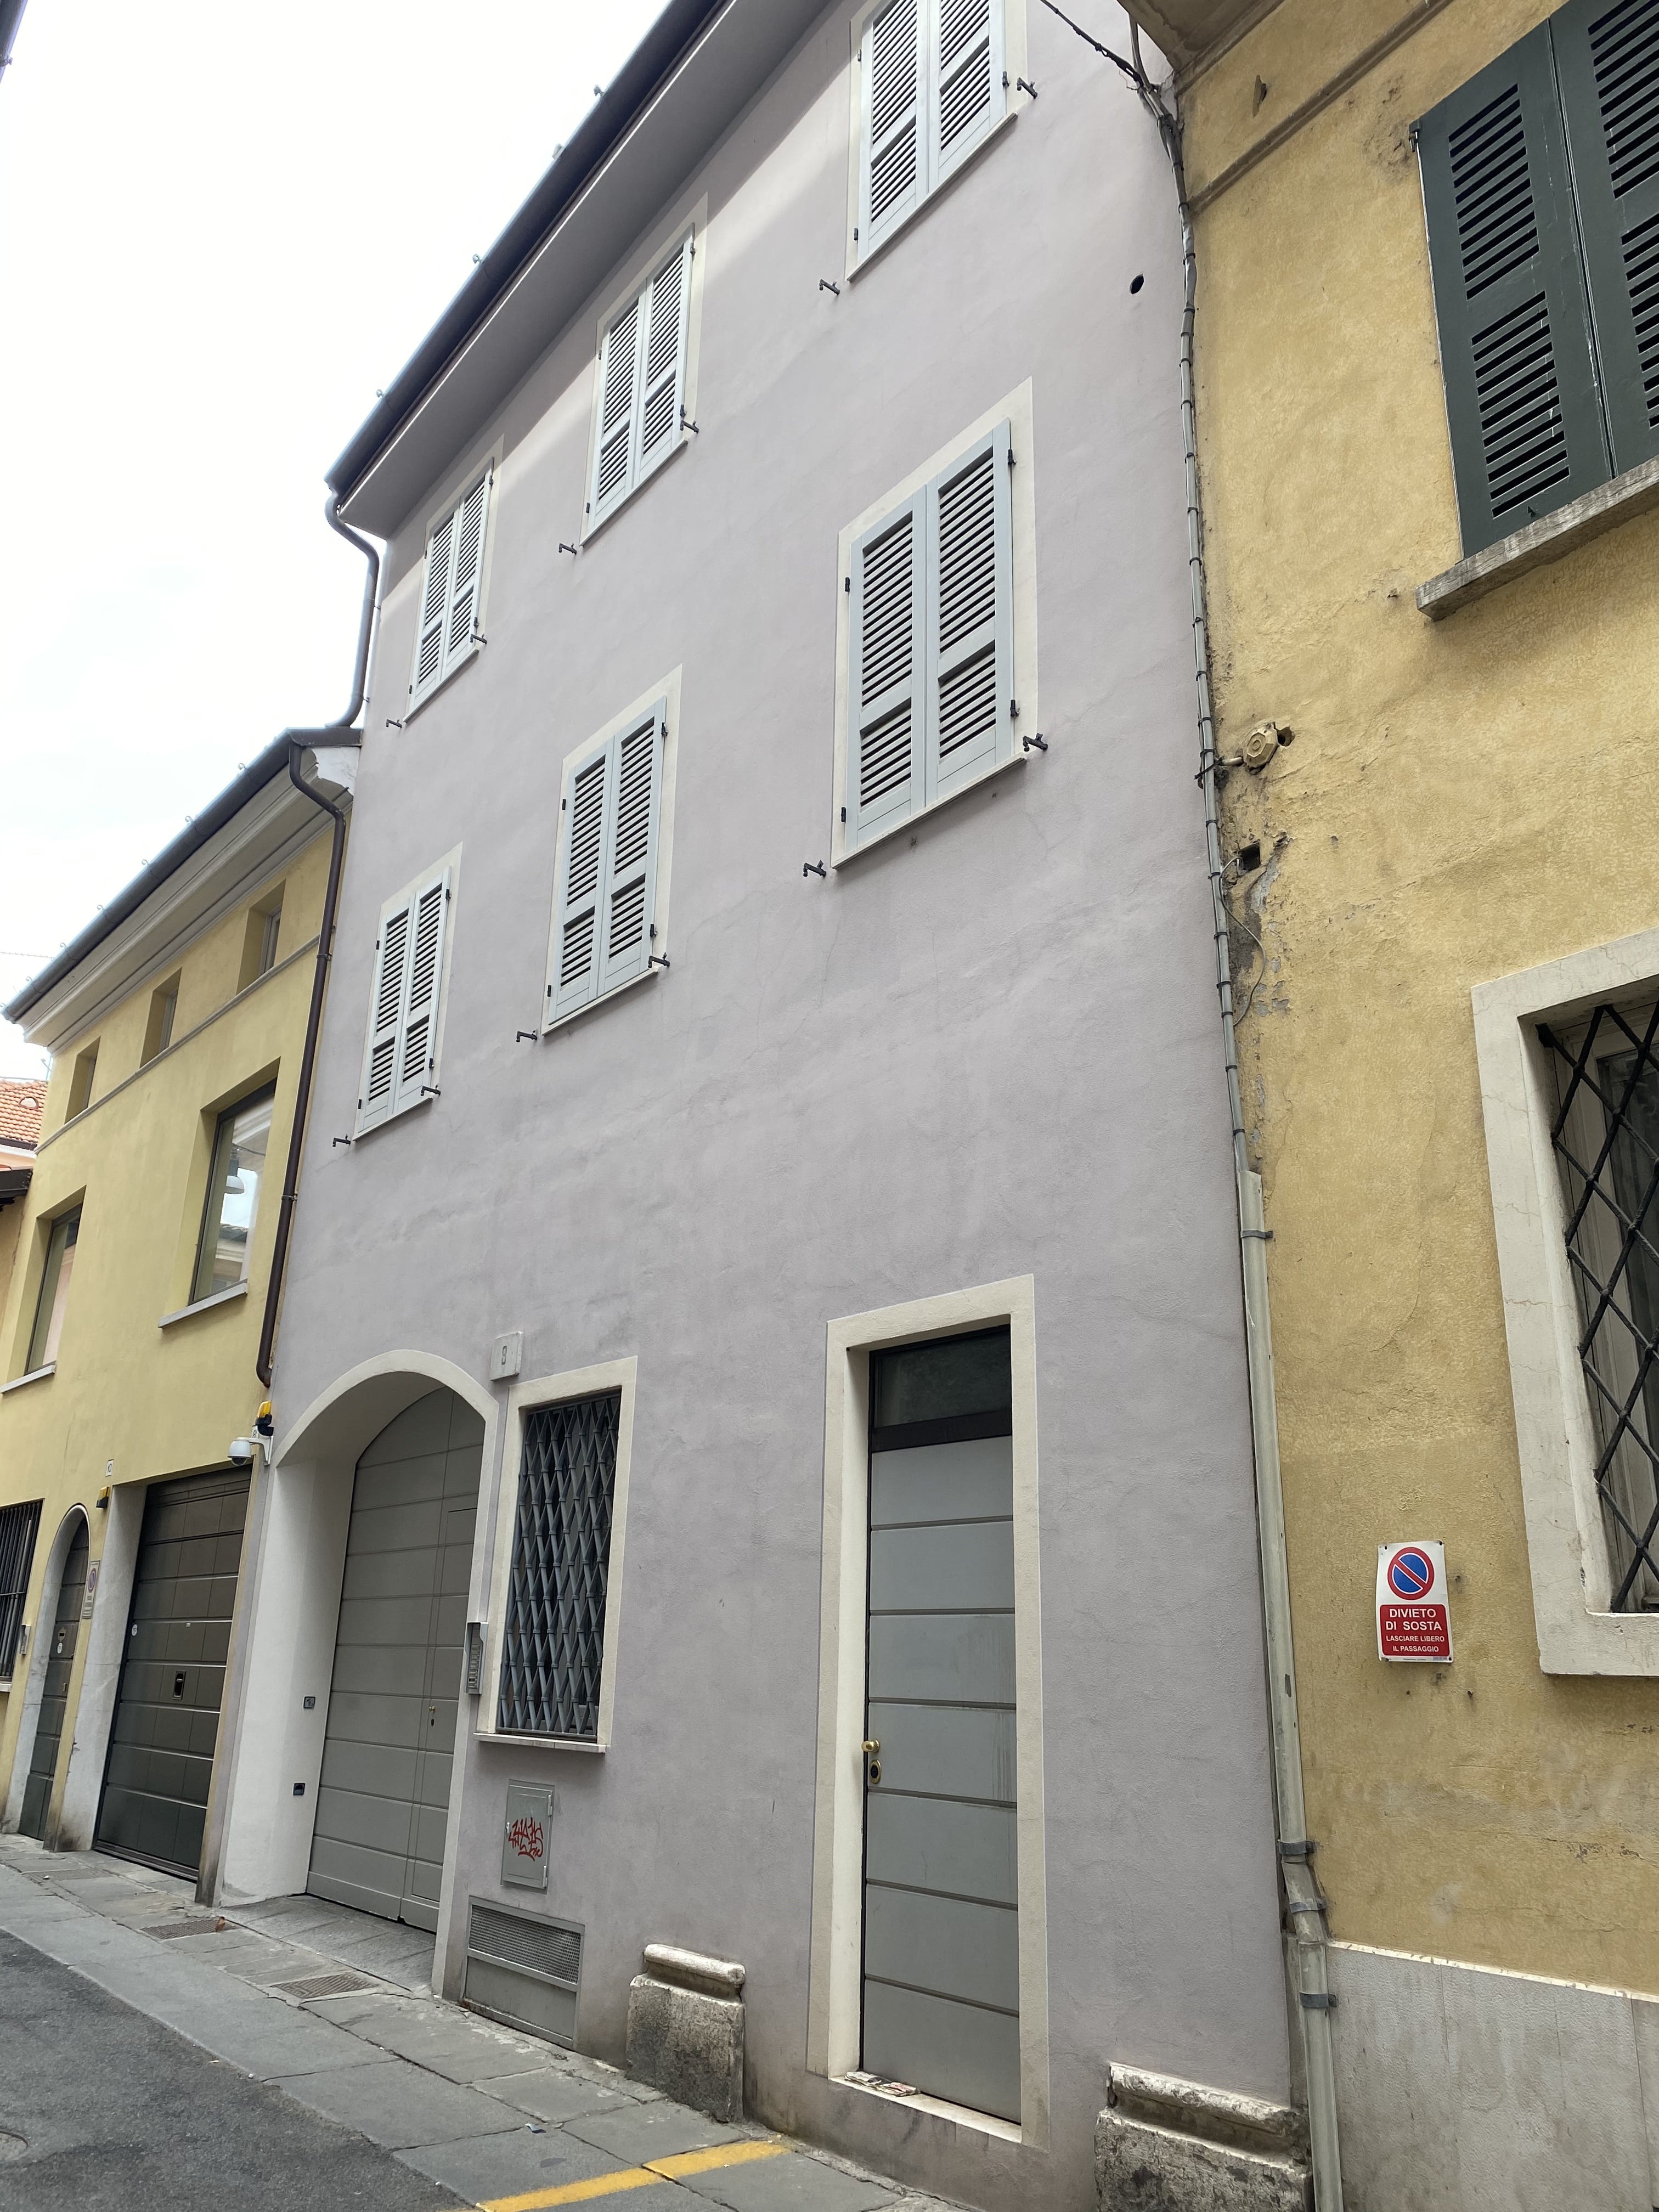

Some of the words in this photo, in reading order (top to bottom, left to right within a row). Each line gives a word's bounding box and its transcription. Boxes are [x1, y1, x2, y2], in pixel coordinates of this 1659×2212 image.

[1389, 1609, 1436, 1618] DIVIETO
[1385, 1621, 1397, 1630] DI
[1403, 1621, 1442, 1630] SOSTA
